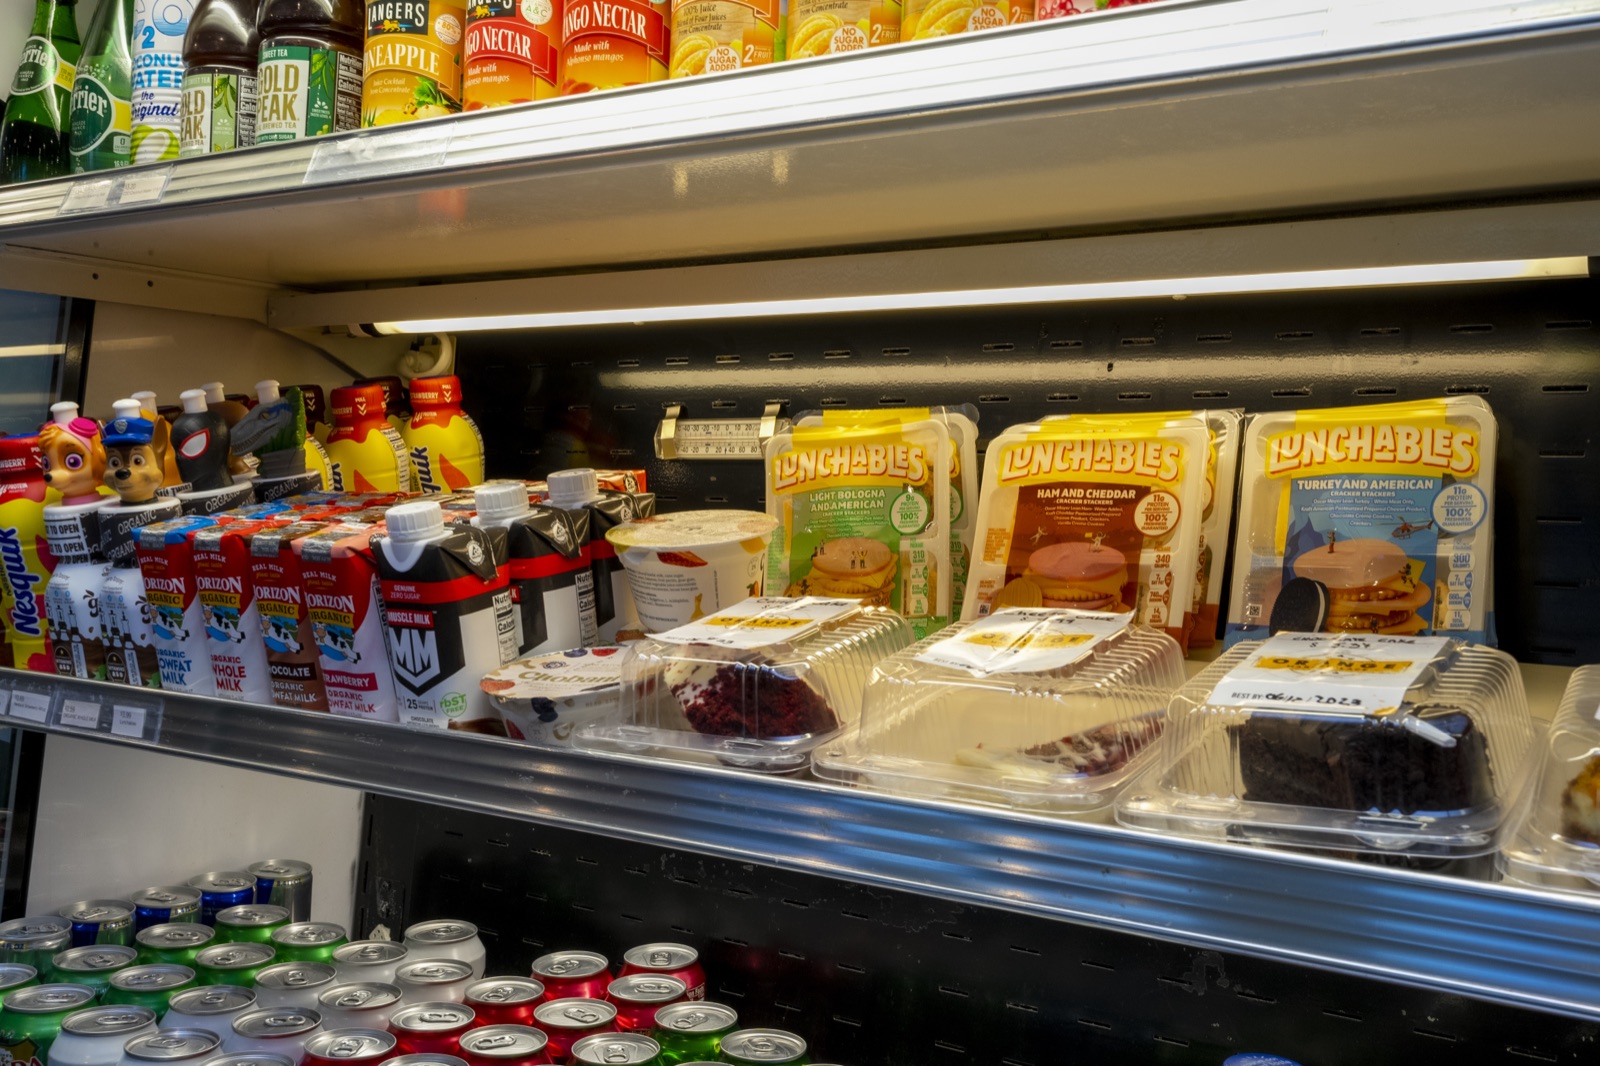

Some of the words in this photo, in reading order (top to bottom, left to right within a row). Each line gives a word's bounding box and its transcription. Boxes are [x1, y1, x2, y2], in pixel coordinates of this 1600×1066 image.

[700, 3, 717, 13] Juice
[811, 2, 849, 13] Concentrate
[981, 8, 996, 17] NO
[367, 2, 426, 31] LANGERS
[592, 1, 647, 40] NECTAR
[695, 15, 709, 23] Four
[709, 14, 727, 22] Juices
[971, 16, 1004, 26] SUGAR
[688, 24, 723, 34] Concentrate
[842, 27, 856, 36] NO
[870, 23, 882, 44] 2
[881, 31, 900, 39] FRUIT
[481, 26, 532, 60] NECTAR
[834, 36, 865, 45] SUGAR
[277, 48, 288, 57] TEA
[573, 42, 592, 54] Made
[593, 40, 610, 51] with
[716, 48, 730, 57] NO
[593, 53, 624, 63] mangos
[743, 44, 755, 64] 2
[753, 51, 772, 59] FRUIT
[364, 43, 440, 77] INEAPPLE
[708, 56, 737, 65] SUGAR
[482, 62, 497, 73] with
[709, 63, 737, 72] ADDED
[258, 64, 299, 95] GOLD
[482, 75, 510, 84] mangos
[140, 90, 155, 101] the
[257, 94, 299, 123] PEAK
[701, 424, 710, 432] -20
[711, 424, 721, 432] -10
[734, 424, 742, 432] 10
[745, 423, 752, 431] 20
[690, 446, 700, 454] -20
[715, 446, 723, 454] 20
[728, 446, 736, 454] 40
[738, 446, 746, 454] 60
[750, 446, 758, 454] 80
[1269, 423, 1475, 475] LUNCHABLES
[1001, 438, 1180, 482] LUNCHABLES
[775, 443, 924, 491] LUNCHABLES
[1297, 479, 1342, 490] TURKEY
[1343, 479, 1368, 490] AND
[1369, 479, 1434, 490] AMERICAN
[809, 491, 836, 502] LIGHT
[837, 488, 886, 500] BOLOGNA
[1037, 488, 1061, 499] HAM
[1061, 488, 1085, 499] AND
[1085, 487, 1137, 499] CHEDDAR
[1361, 490, 1396, 498] STACKERS
[811, 502, 832, 512] AND
[831, 500, 884, 510] AMERICAN
[1083, 498, 1114, 506] STACKERS
[899, 512, 919, 521] 100%
[1144, 513, 1168, 522] 100%
[1445, 507, 1472, 517] 100%
[117, 508, 157, 535] ORGANIC
[50, 525, 58, 535] TO
[58, 523, 79, 535] OPEN
[55, 544, 62, 553] TO
[63, 541, 85, 553] OPEN
[950, 541, 961, 550] 310
[140, 556, 153, 564] REAL
[154, 556, 169, 566] MILK
[194, 552, 208, 562] REAL
[210, 552, 227, 563] MILK
[912, 551, 925, 560] 310
[1155, 554, 1171, 564] 340
[252, 563, 267, 572] REAL
[268, 563, 284, 574] MILK
[0, 527, 41, 636] Nesquik
[302, 571, 318, 580] REAL
[319, 571, 337, 583] MILK
[143, 577, 186, 594] ORIZON
[195, 576, 243, 594] ORIZON
[393, 584, 416, 593] GENUINE
[390, 591, 404, 599] ZERO
[387, 611, 414, 623] MUSCLE
[413, 613, 431, 625] MILK
[159, 659, 192, 673] OWFAT
[1272, 657, 1398, 670] ORANGE
[270, 664, 311, 677] OCOLATE
[162, 672, 187, 686] MILK
[323, 673, 370, 688] RAWBERRY
[216, 678, 243, 692] MILK
[294, 691, 317, 703] MILK
[328, 689, 363, 702] ORGANIC
[1231, 691, 1251, 699] BEST
[328, 699, 354, 710] OWFAT
[355, 702, 377, 713] MILK
[406, 698, 418, 710] 25
[439, 694, 467, 708] rbST
[445, 705, 465, 714] FREE
